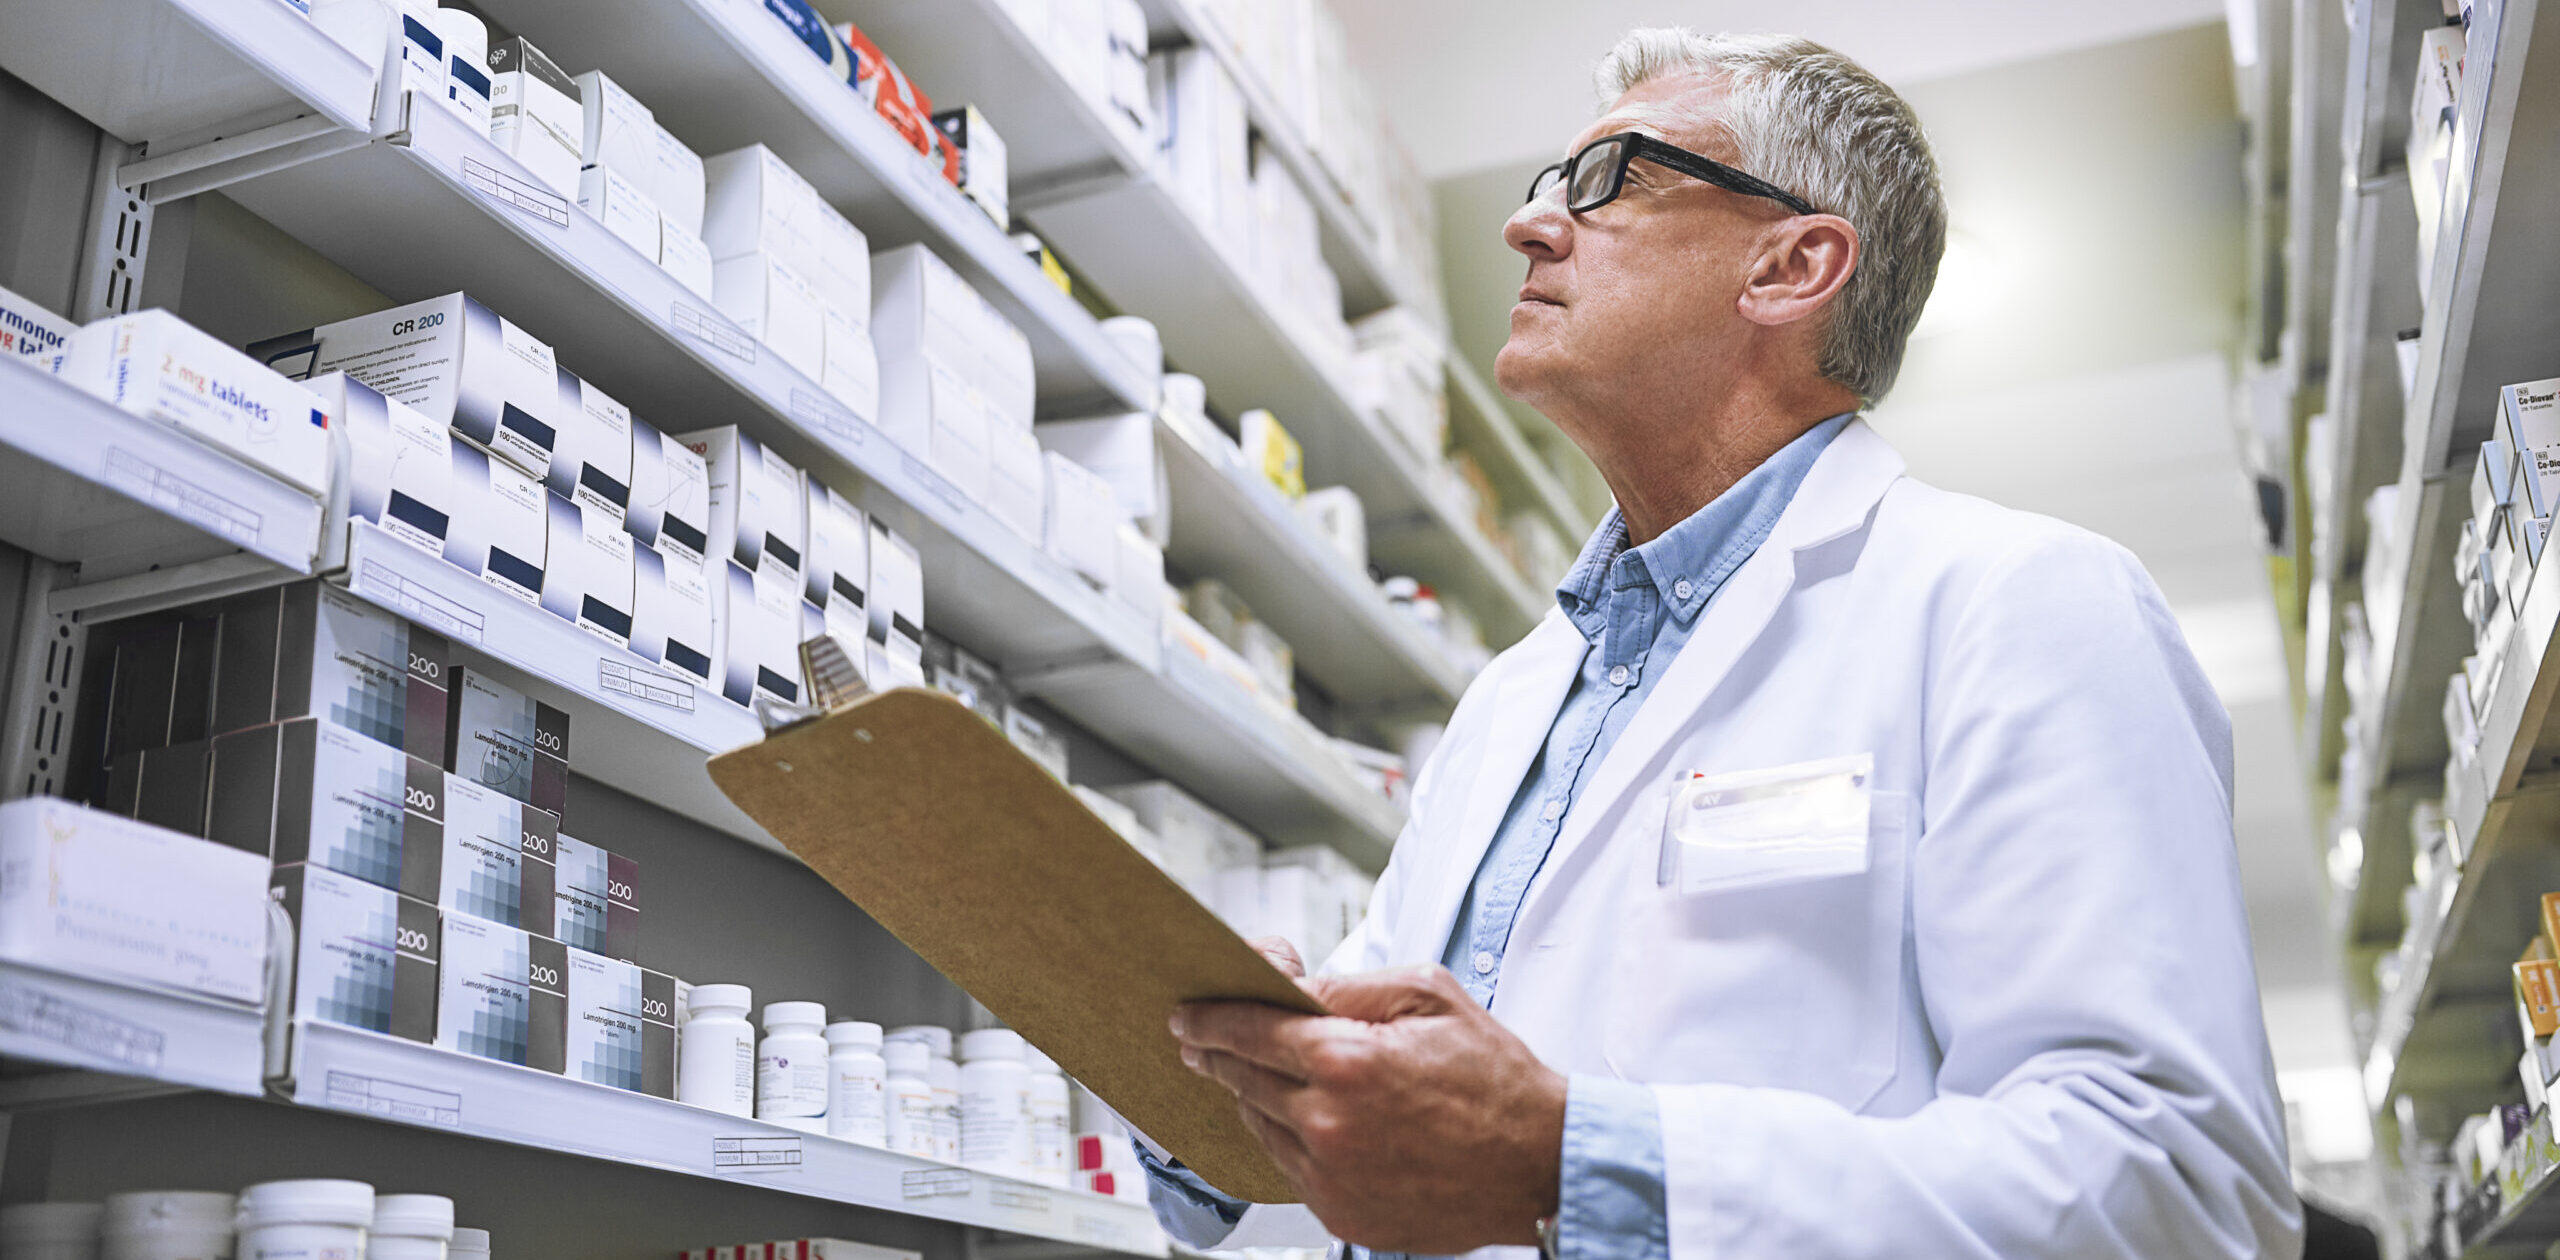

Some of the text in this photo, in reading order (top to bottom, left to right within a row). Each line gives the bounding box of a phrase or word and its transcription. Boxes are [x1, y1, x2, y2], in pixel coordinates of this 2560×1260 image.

[393, 313, 444, 336] CR 200
[162, 354, 172, 374] 2
[178, 366, 205, 395] mg
[211, 378, 269, 422] tablets
[499, 430, 510, 442] 100
[578, 488, 588, 500] 100
[409, 652, 439, 678] 200
[475, 730, 528, 761] Lamotrigine 200 mg
[535, 728, 560, 751] 200
[405, 786, 435, 811] 200
[522, 831, 548, 854] 200
[608, 879, 632, 901] 200
[396, 926, 428, 951] 200
[530, 963, 558, 985] 200
[642, 997, 667, 1018] 200
[583, 1011, 637, 1034] Lamotrigien 200 mg
